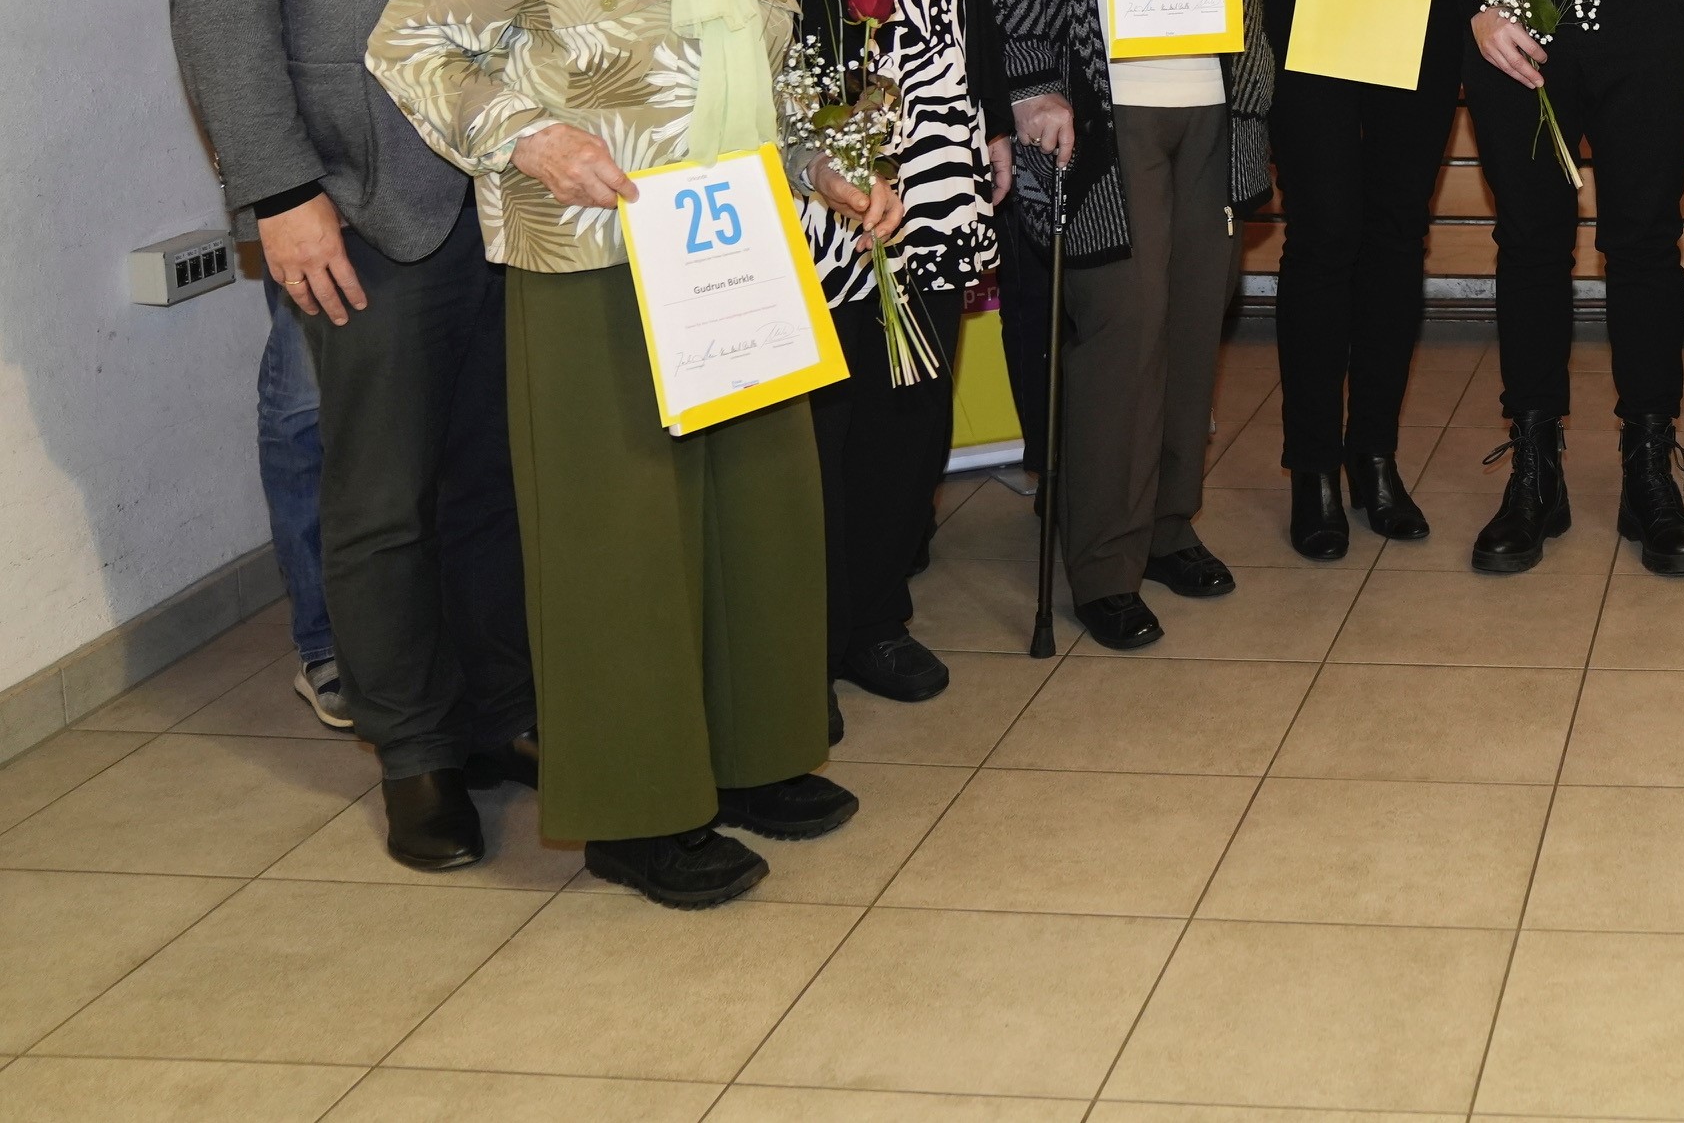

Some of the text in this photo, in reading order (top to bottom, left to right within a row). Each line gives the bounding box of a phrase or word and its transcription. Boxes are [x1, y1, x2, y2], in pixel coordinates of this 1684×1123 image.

[674, 181, 742, 255] 25
[693, 274, 755, 295] Gudrun Bürkle
